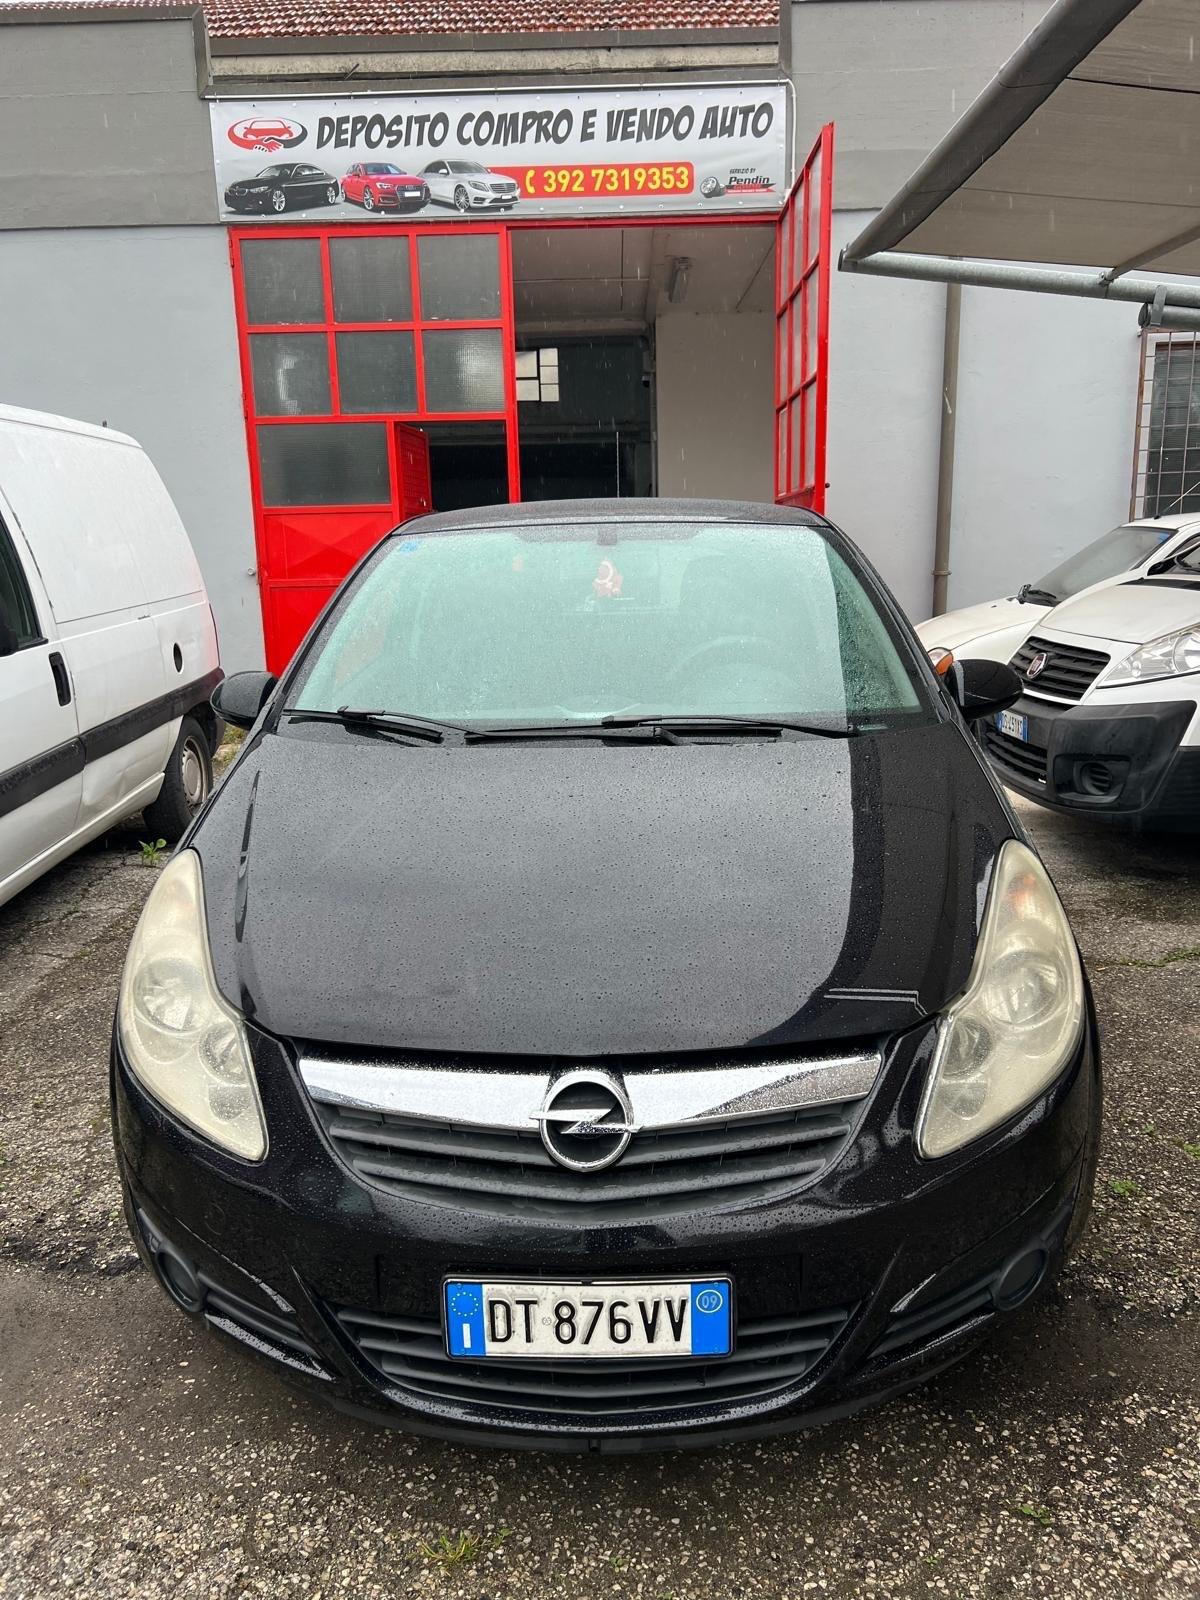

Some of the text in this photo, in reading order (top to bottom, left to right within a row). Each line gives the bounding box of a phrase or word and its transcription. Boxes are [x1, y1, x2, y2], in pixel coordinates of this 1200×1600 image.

[316, 102, 774, 150] DEPOSITO COMPRO E VENDO AUTO
[543, 166, 689, 193] 392 7319353
[729, 176, 769, 184] Pendin
[701, 1295, 717, 1308] 09
[488, 1298, 688, 1345] DT 876VV
